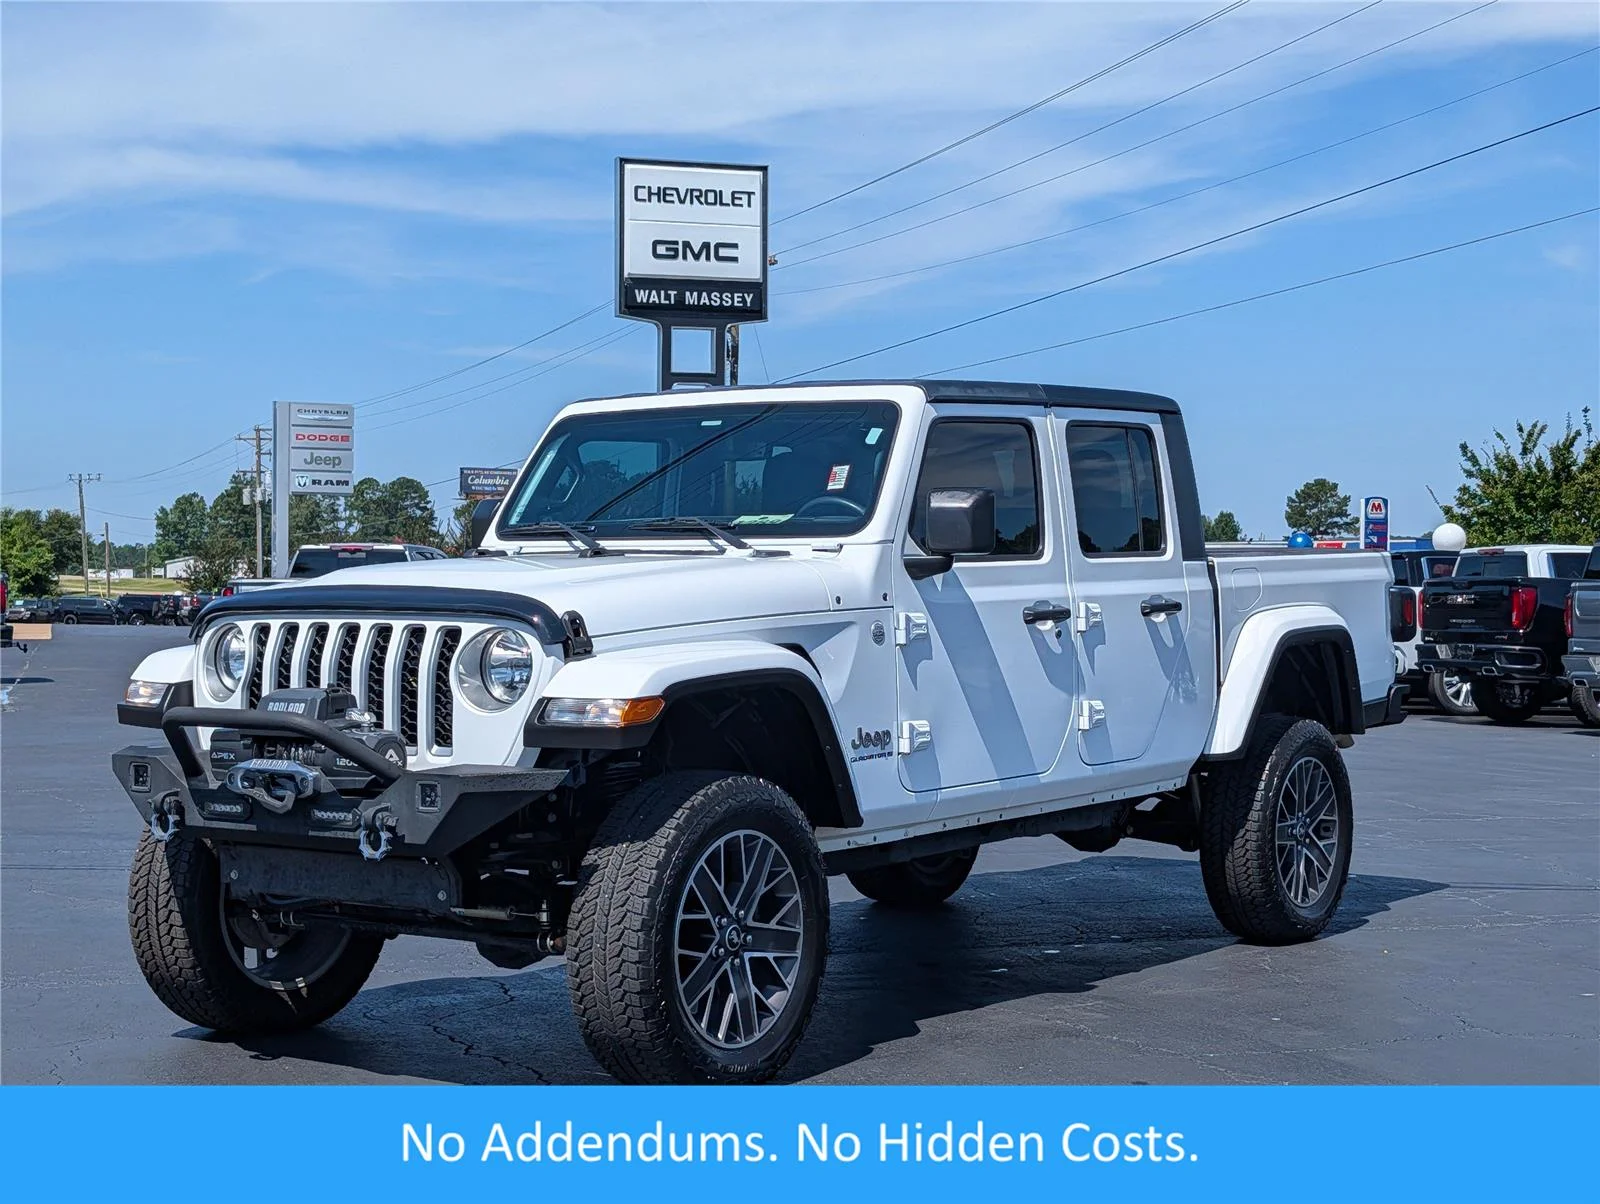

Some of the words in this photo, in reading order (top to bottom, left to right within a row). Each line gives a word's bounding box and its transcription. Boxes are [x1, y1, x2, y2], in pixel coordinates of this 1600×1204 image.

[634, 185, 756, 208] CHEVROLET
[651, 239, 739, 263] GMC
[635, 289, 677, 304] WALT
[685, 291, 754, 307] MASSEY
[295, 433, 350, 443] DODGE
[303, 452, 342, 468] Jeep
[467, 475, 510, 485] Columbia
[850, 727, 891, 750] Jeep
[211, 751, 235, 760] APEX
[850, 753, 887, 763] GLADIATOR
